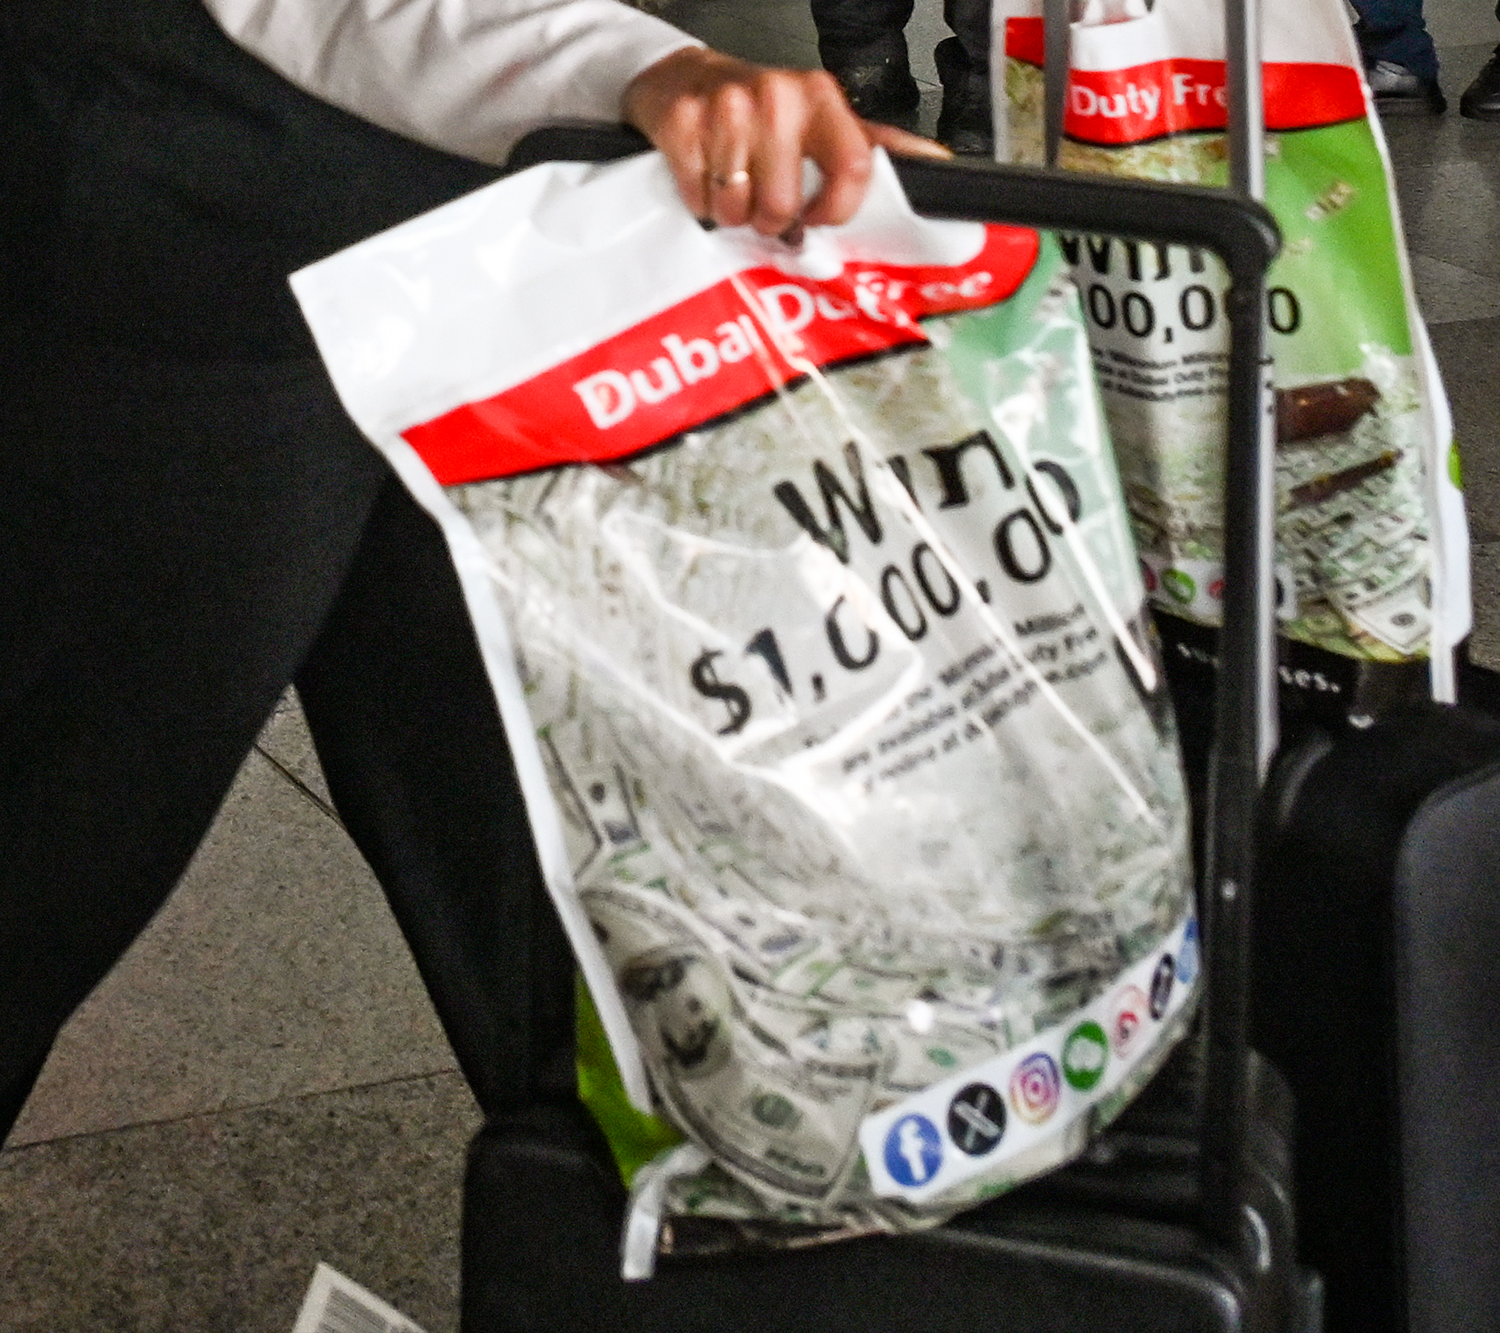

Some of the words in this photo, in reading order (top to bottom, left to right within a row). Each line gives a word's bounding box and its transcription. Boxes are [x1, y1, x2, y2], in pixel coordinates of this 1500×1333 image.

[1071, 77, 1162, 121] Duty
[1170, 71, 1230, 111] Fre
[773, 429, 1015, 566] Win
